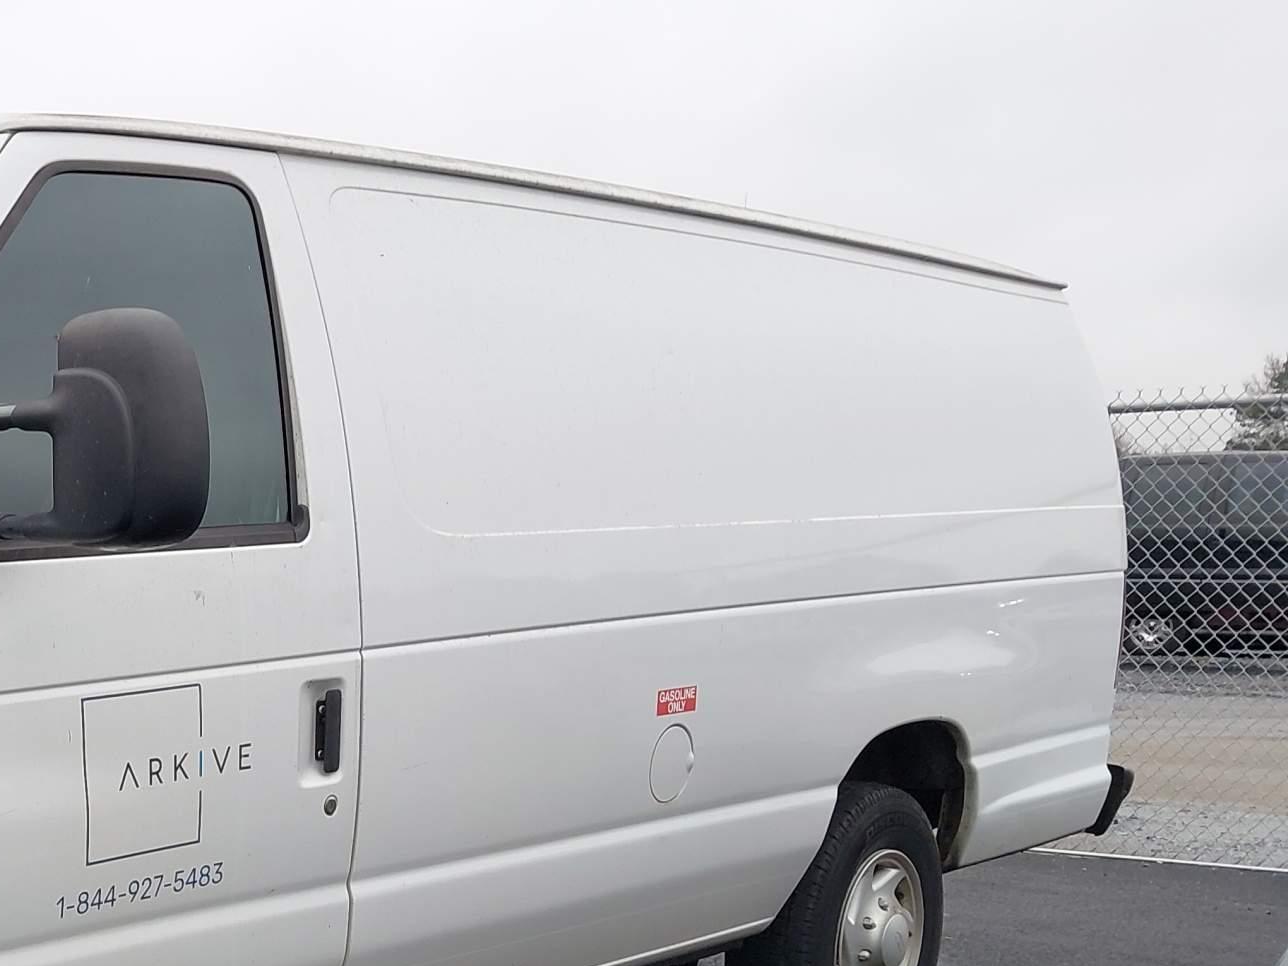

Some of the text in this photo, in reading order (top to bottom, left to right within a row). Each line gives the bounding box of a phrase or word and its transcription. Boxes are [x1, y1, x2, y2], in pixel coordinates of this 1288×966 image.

[659, 687, 696, 703] GASOLINE
[667, 701, 687, 713] ONLY
[119, 743, 252, 791] ARKIVE
[56, 862, 224, 918] 1-844-927-5483
